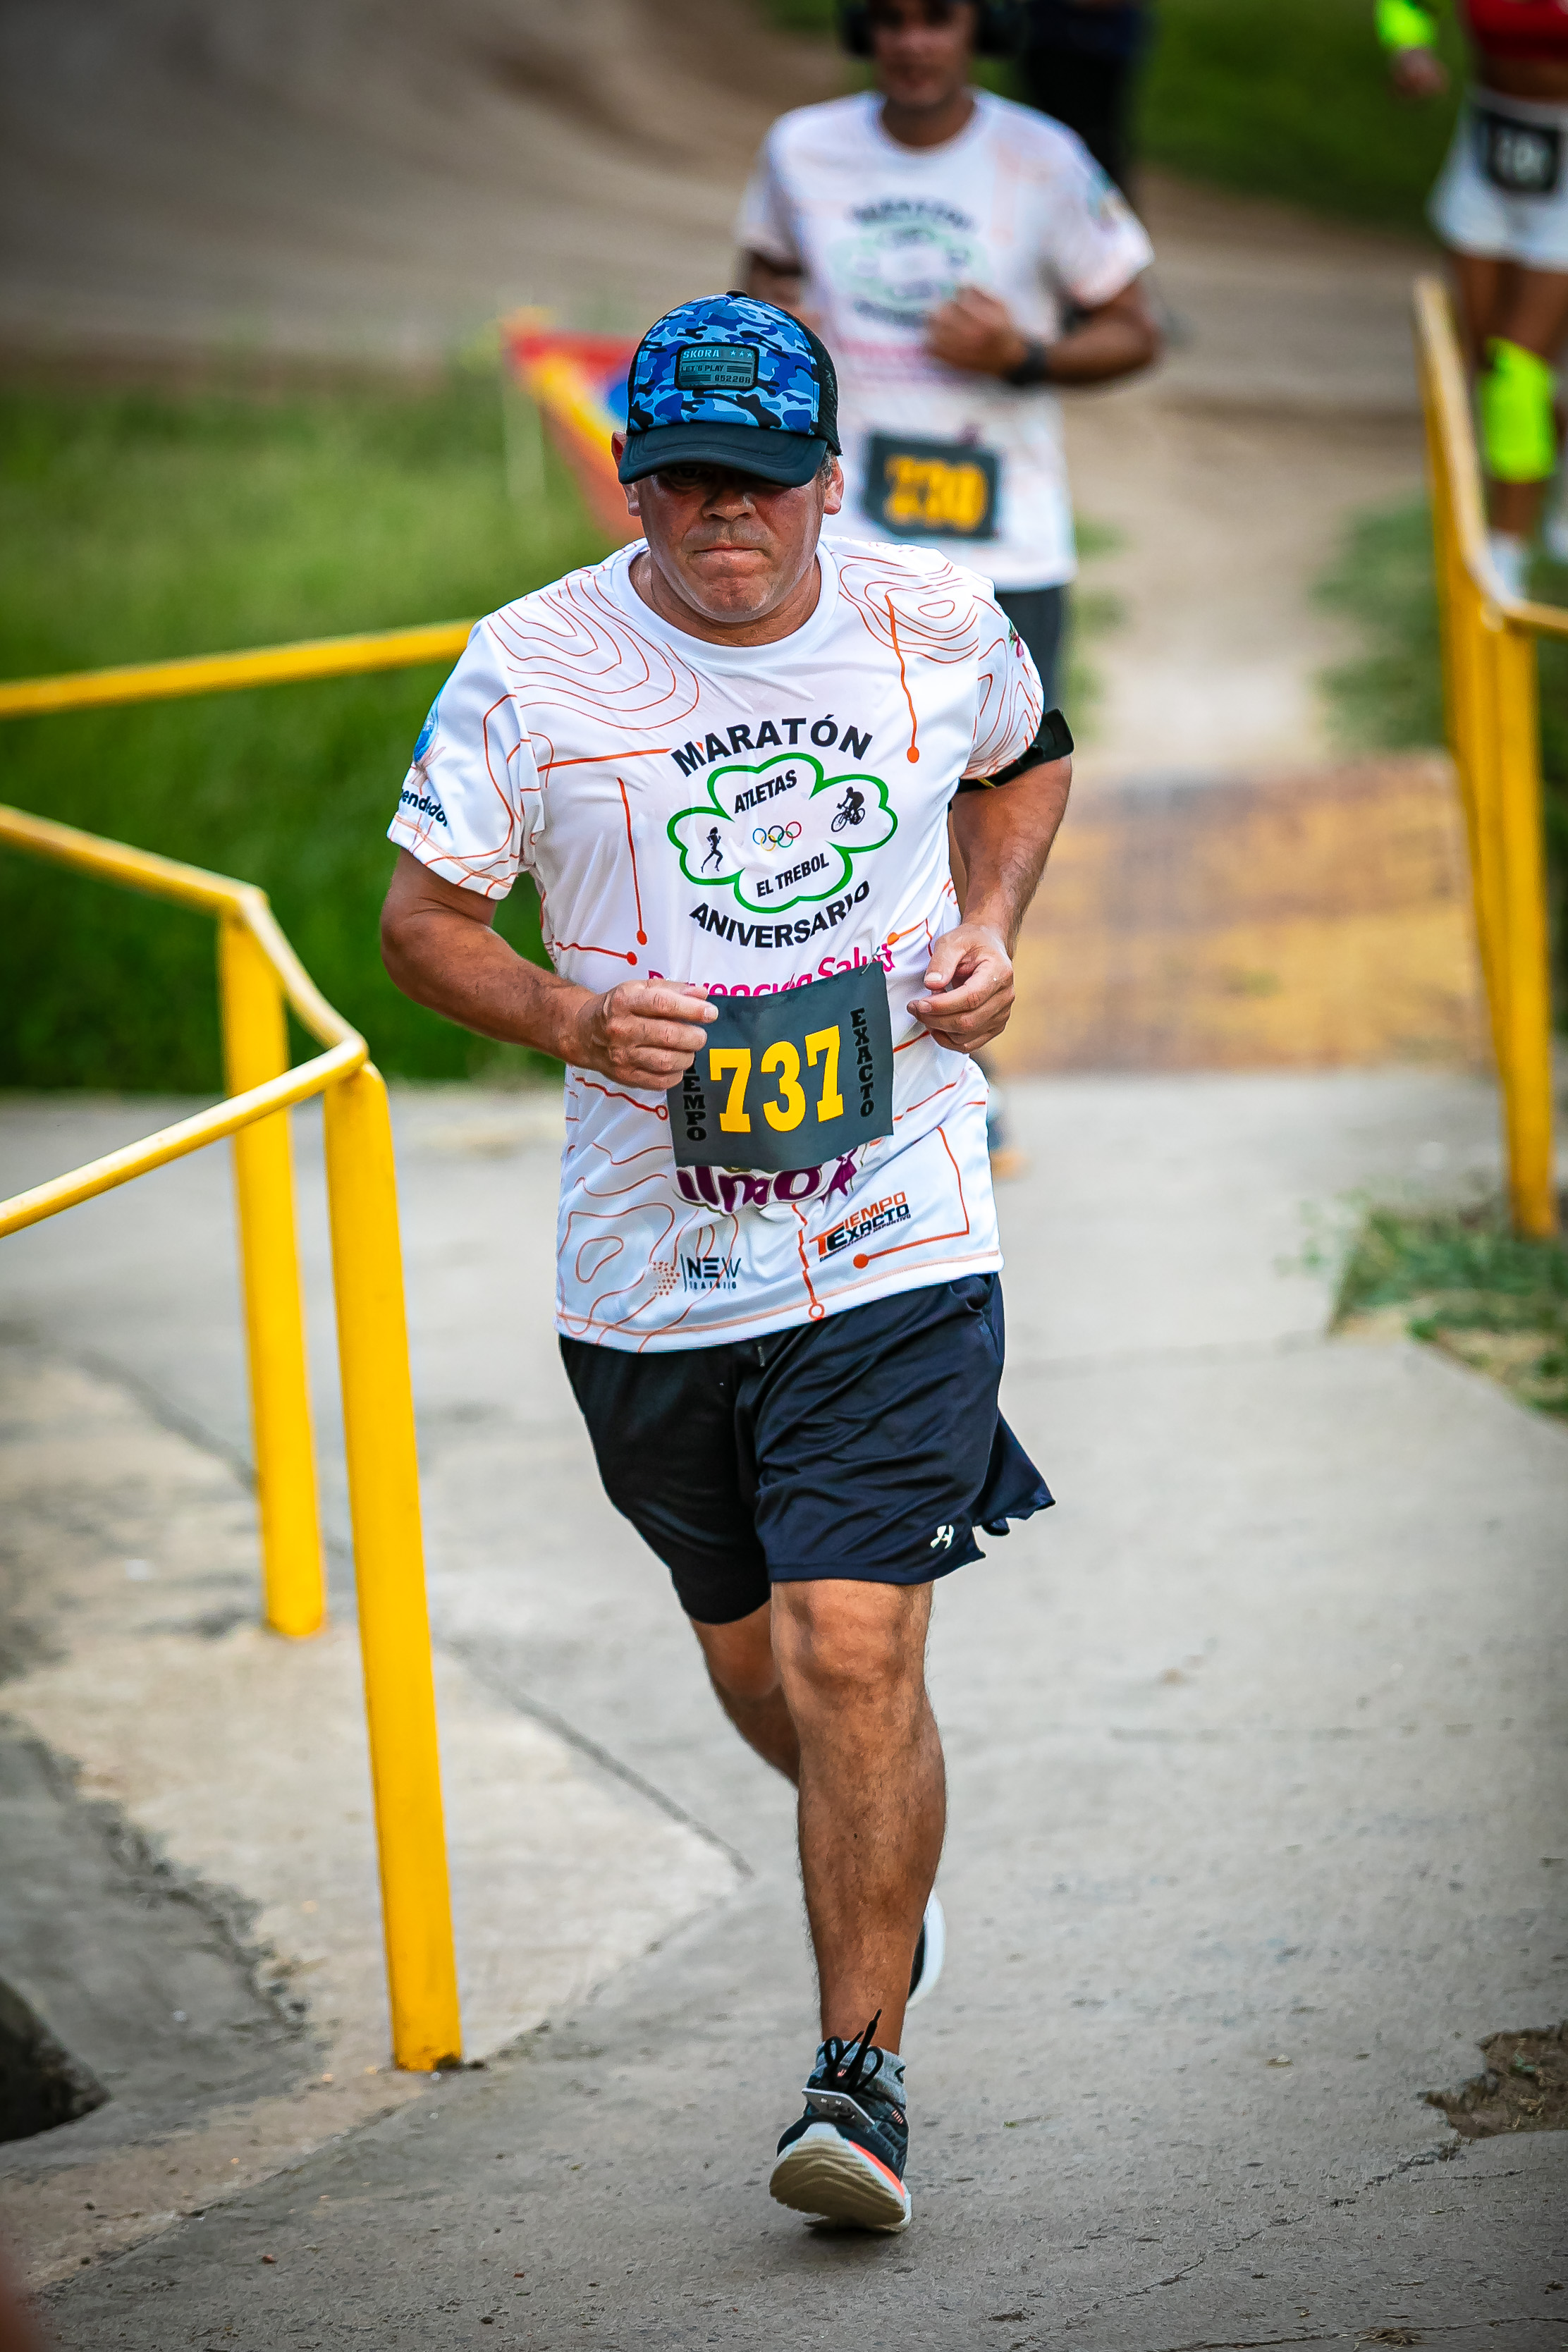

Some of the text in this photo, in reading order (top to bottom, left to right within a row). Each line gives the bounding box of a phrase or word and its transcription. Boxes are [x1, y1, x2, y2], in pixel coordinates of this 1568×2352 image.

[682, 349, 720, 359] SKORA
[671, 713, 874, 778] MARATÓN
[734, 768, 798, 814] ATLETAS
[756, 852, 830, 898] EL TREBOL
[688, 880, 871, 949] ANIVERSARIO
[709, 1024, 844, 1133] 737
[850, 1007, 875, 1118] EXACTO
[826, 1203, 910, 1251] EXACTO
[686, 1256, 742, 1279] NEW
